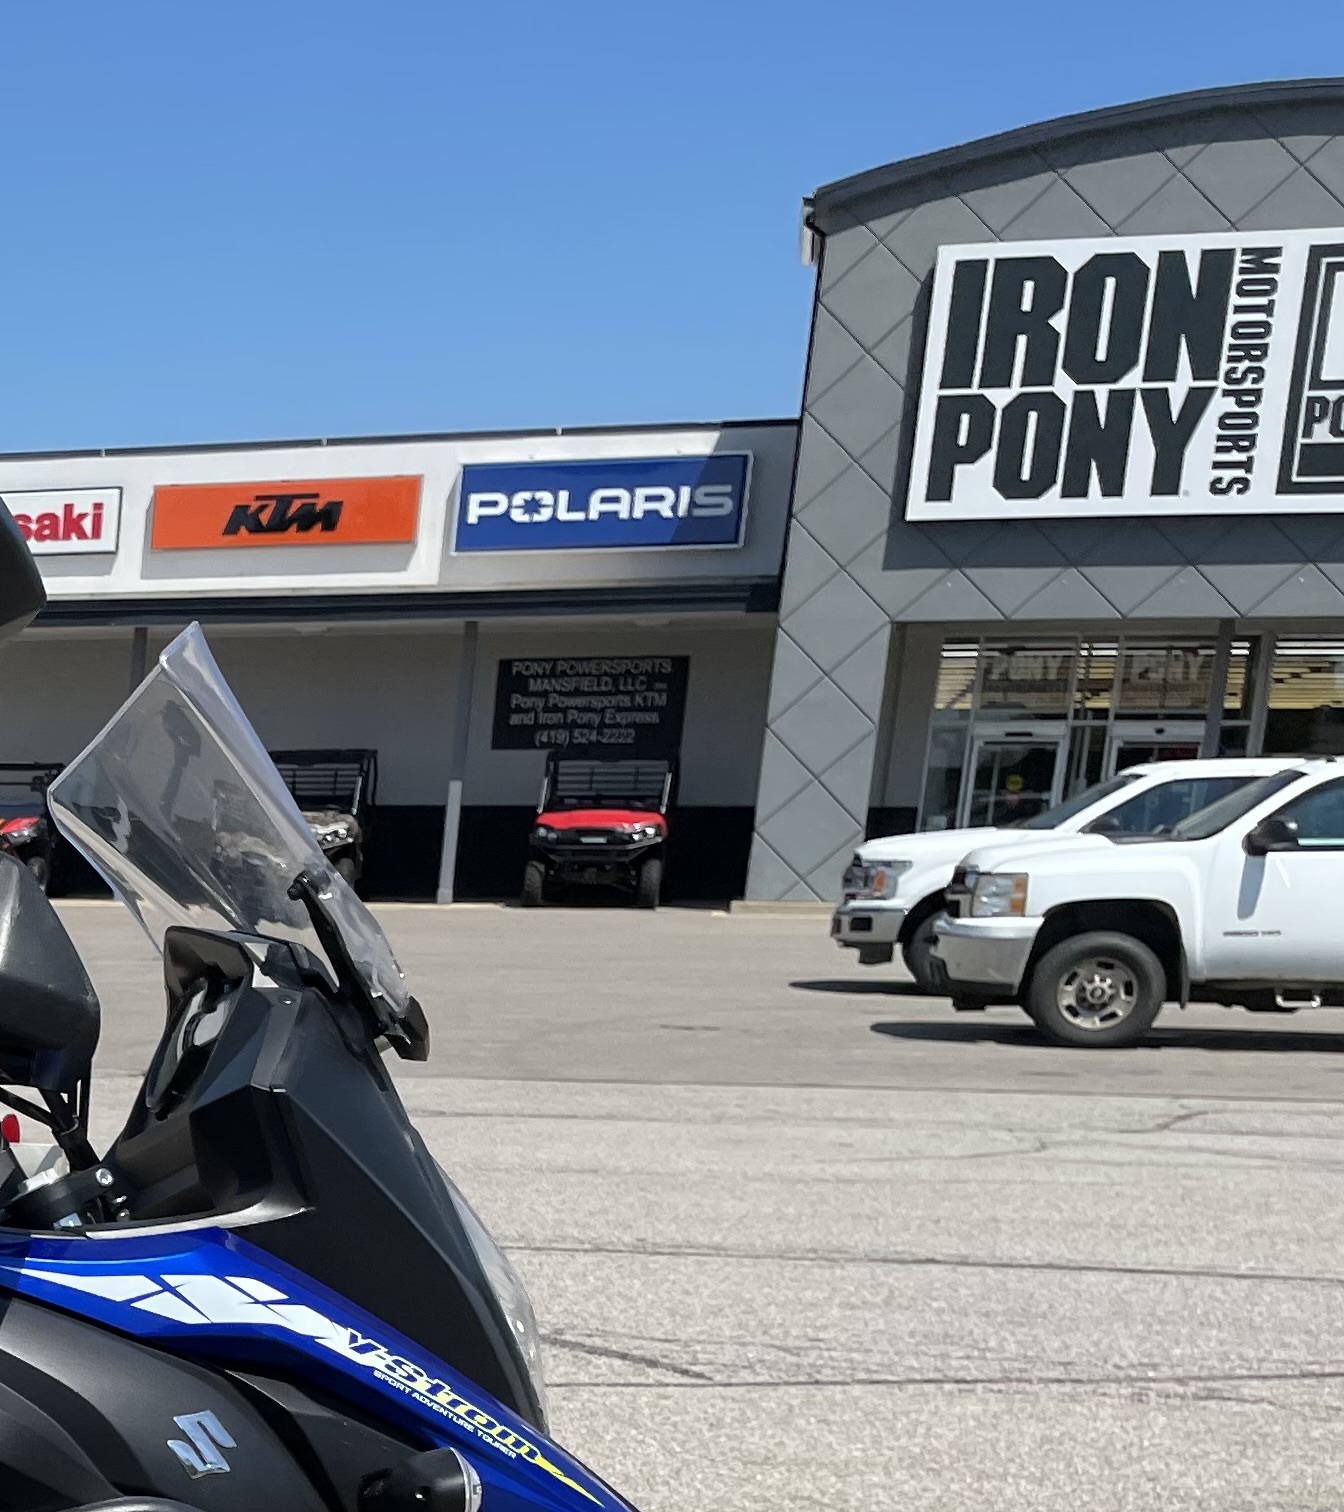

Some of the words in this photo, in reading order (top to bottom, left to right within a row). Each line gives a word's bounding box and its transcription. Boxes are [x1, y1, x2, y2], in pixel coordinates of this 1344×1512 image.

[939, 248, 1236, 390] IRON
[1209, 246, 1283, 497] MOTORSPORTS
[925, 386, 1219, 502] PONY
[221, 492, 343, 536] KTM
[467, 483, 732, 526] POLARIS
[512, 661, 553, 676] PONY
[555, 658, 672, 675] POWERSPORTS
[619, 676, 648, 691] LLC
[509, 712, 535, 725] and
[537, 711, 563, 725] Iron
[566, 708, 602, 727] Pony
[604, 708, 660, 726] Express
[512, 693, 545, 711] Pony
[547, 693, 632, 709] Powersports
[634, 691, 668, 707] KTM
[534, 728, 569, 748] (419)
[571, 728, 635, 744] 524-2222
[348, 1328, 542, 1463] V-Strom
[372, 1369, 411, 1395] SPORT
[412, 1391, 474, 1433] ADVENTURE
[477, 1429, 517, 1460] TOURER
